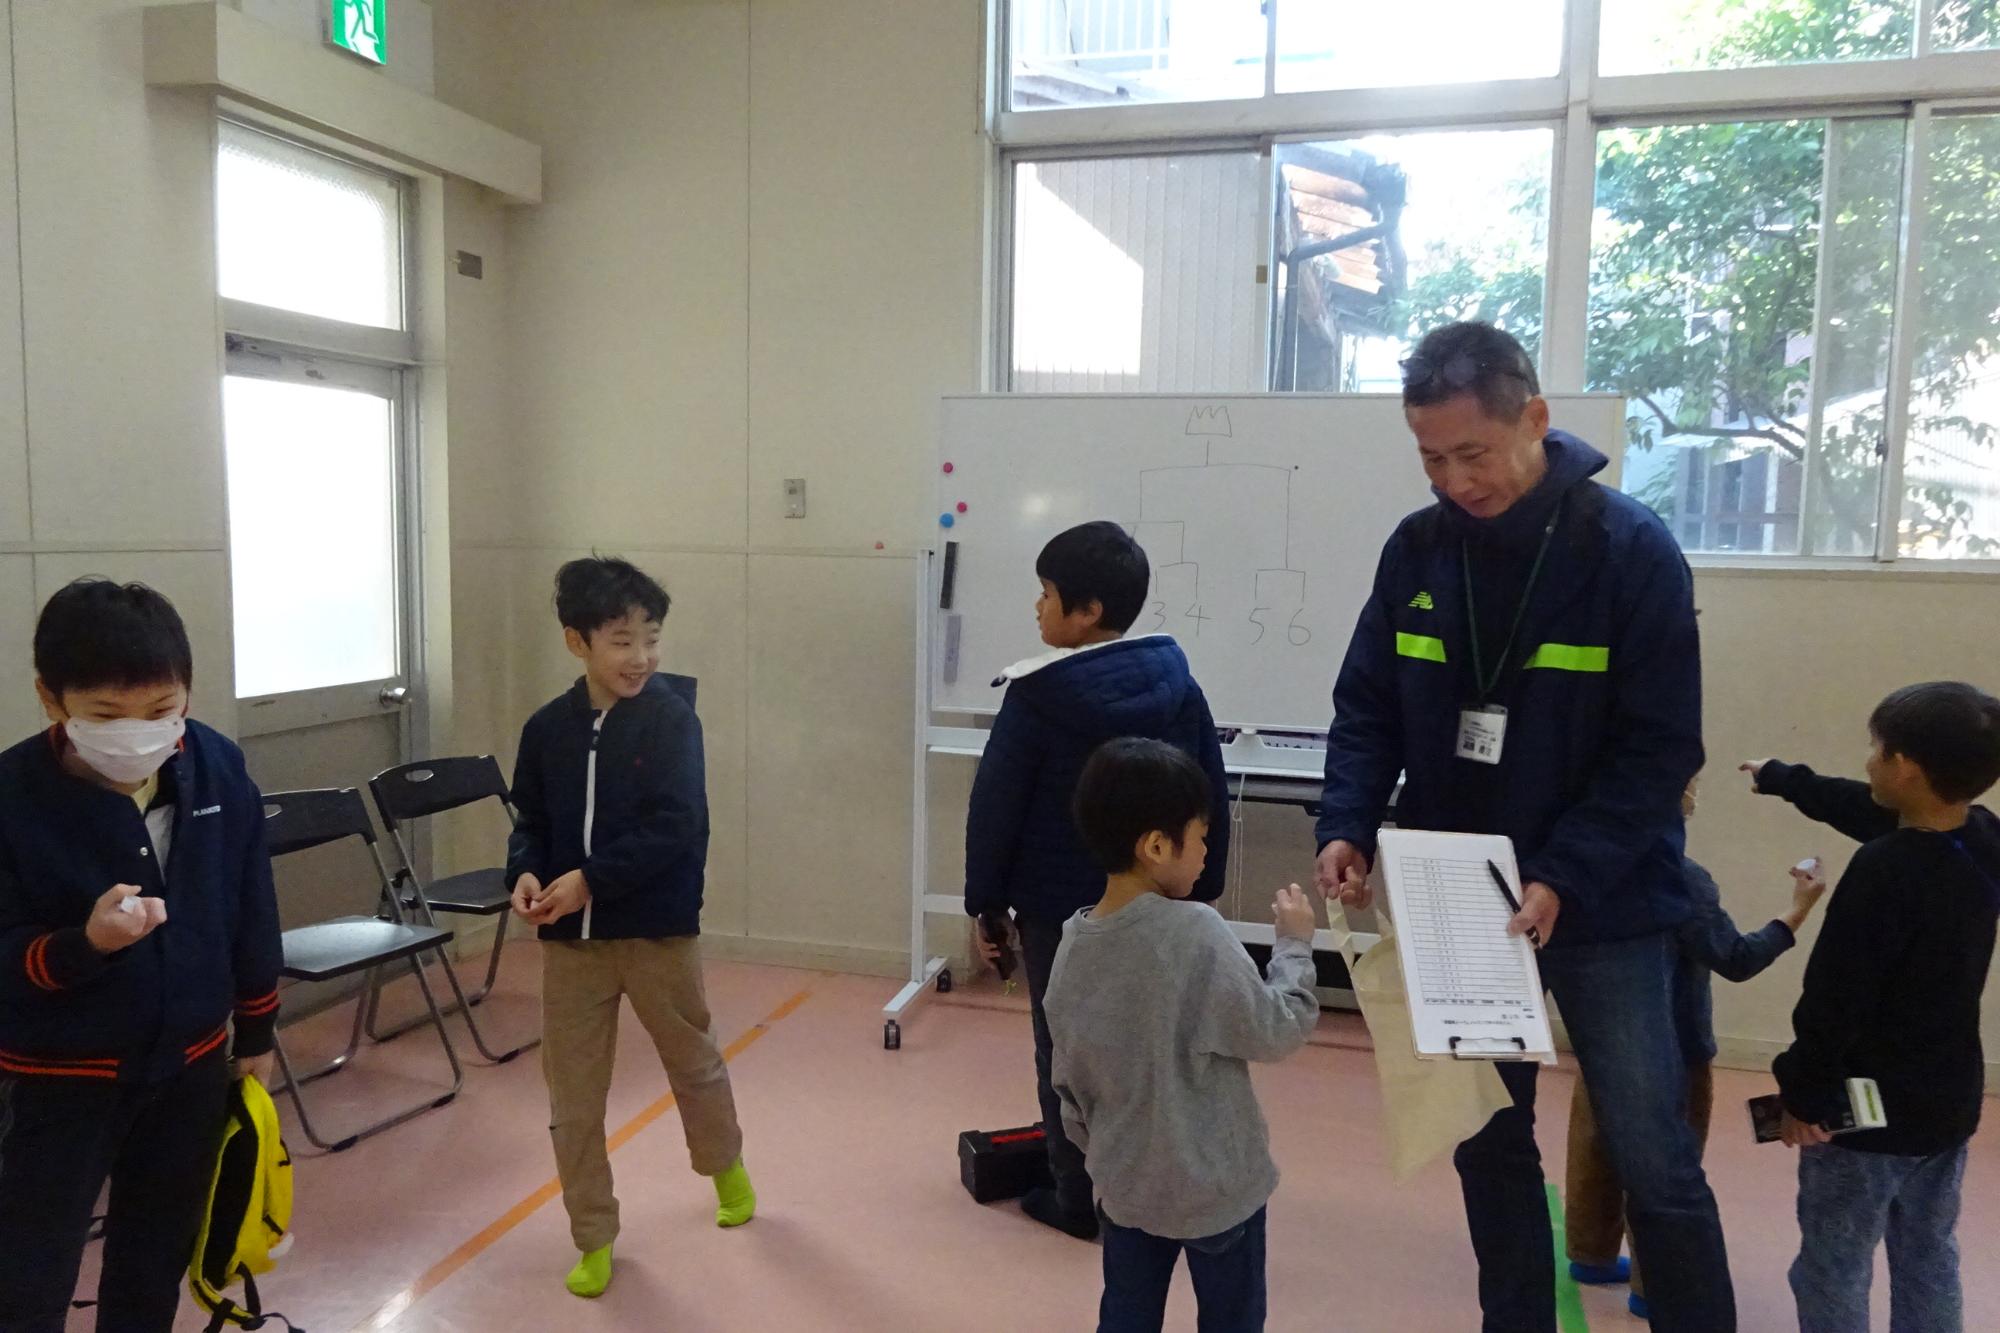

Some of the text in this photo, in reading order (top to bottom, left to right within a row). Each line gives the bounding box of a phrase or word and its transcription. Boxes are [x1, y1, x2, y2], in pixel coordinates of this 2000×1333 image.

[1152, 602, 1312, 647] 3 4 5 6
